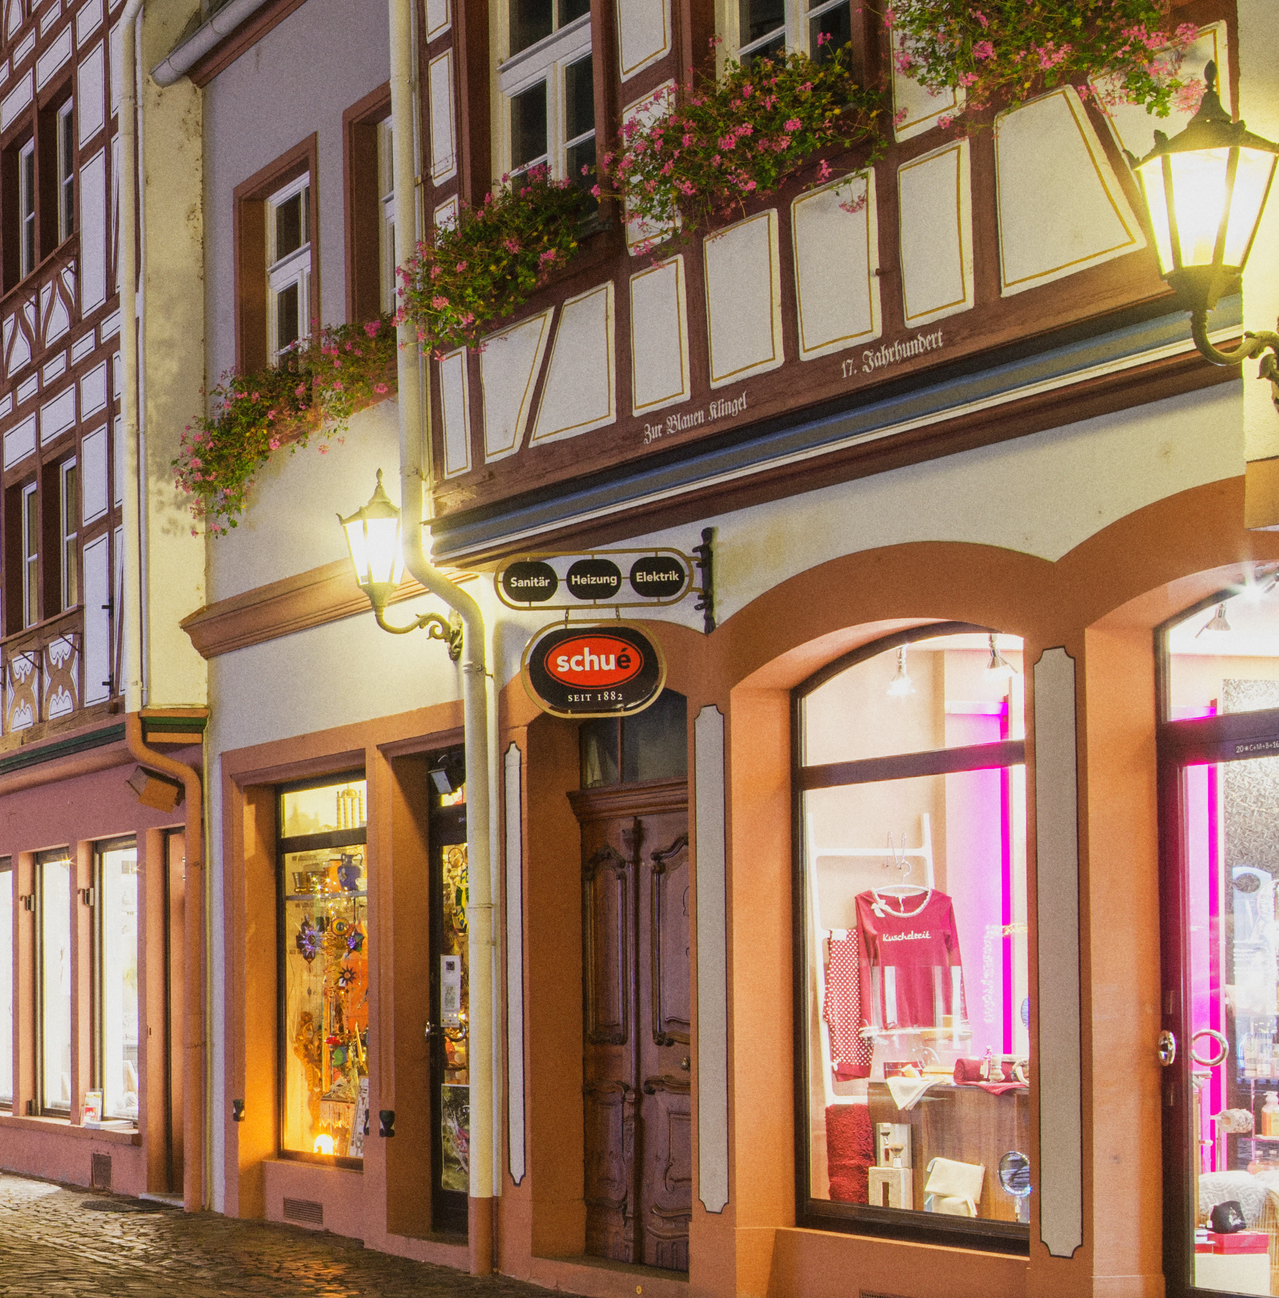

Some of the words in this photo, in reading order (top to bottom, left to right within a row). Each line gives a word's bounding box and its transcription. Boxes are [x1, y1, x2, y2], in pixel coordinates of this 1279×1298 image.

[841, 357, 858, 378] 17.
[862, 327, 944, 373] Jahrhundert
[643, 423, 663, 445] Zur
[666, 412, 705, 435] Blauen
[708, 390, 747, 421] Klingel
[510, 576, 550, 588] Sanitär
[571, 574, 618, 586] Heizung
[635, 570, 680, 583] Elektrik
[556, 647, 632, 672] schué
[568, 693, 592, 702] SEIT
[597, 691, 623, 701] 1882
[882, 930, 932, 942] Kuschelzeit
